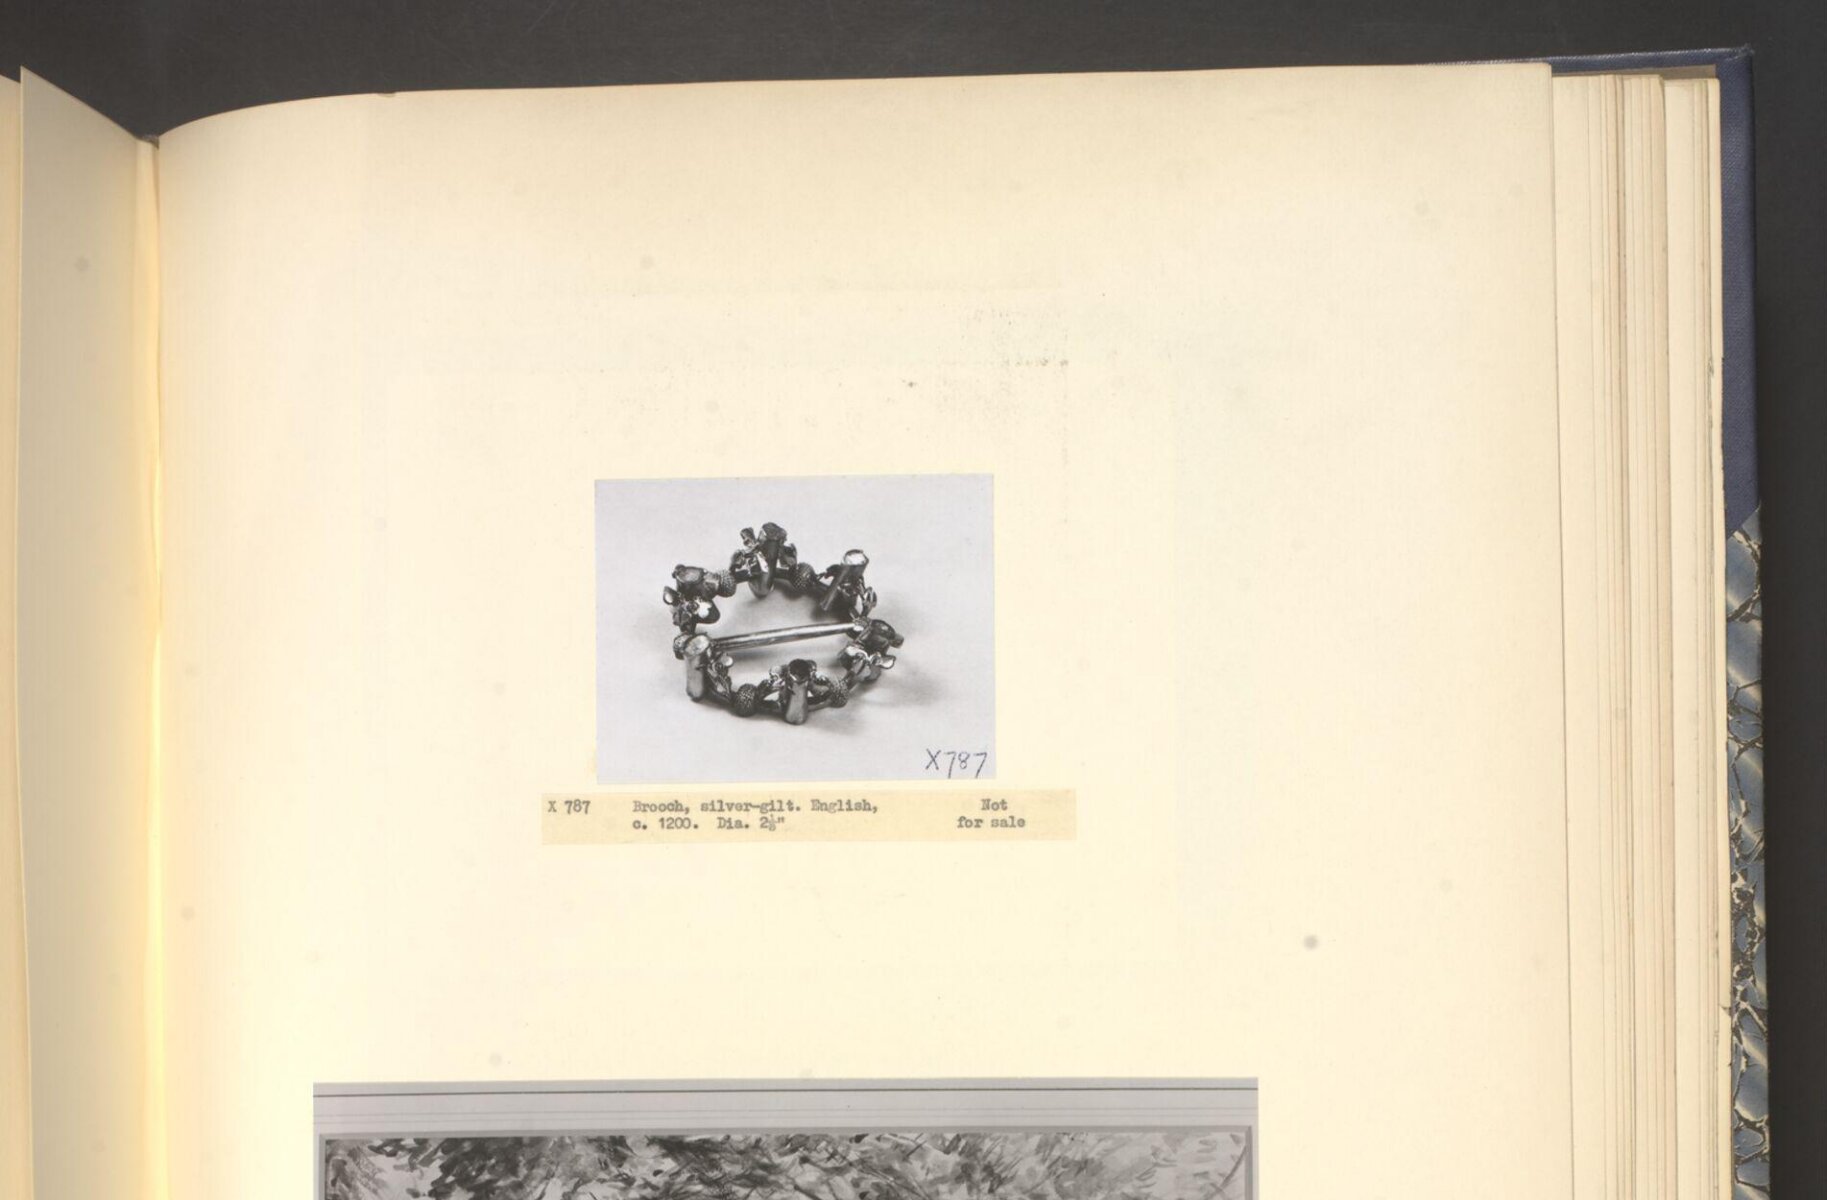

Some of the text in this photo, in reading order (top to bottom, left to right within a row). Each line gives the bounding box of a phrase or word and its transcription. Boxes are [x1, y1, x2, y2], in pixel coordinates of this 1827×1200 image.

[925, 748, 988, 779] X787
[548, 799, 591, 815] X 787
[632, 799, 878, 815] Brooch, silver-gilt. English,
[981, 798, 1008, 811] Not
[632, 819, 648, 830] c.
[659, 817, 699, 830] 1200.
[717, 817, 750, 830] Dia.
[957, 815, 1026, 828] for sale
